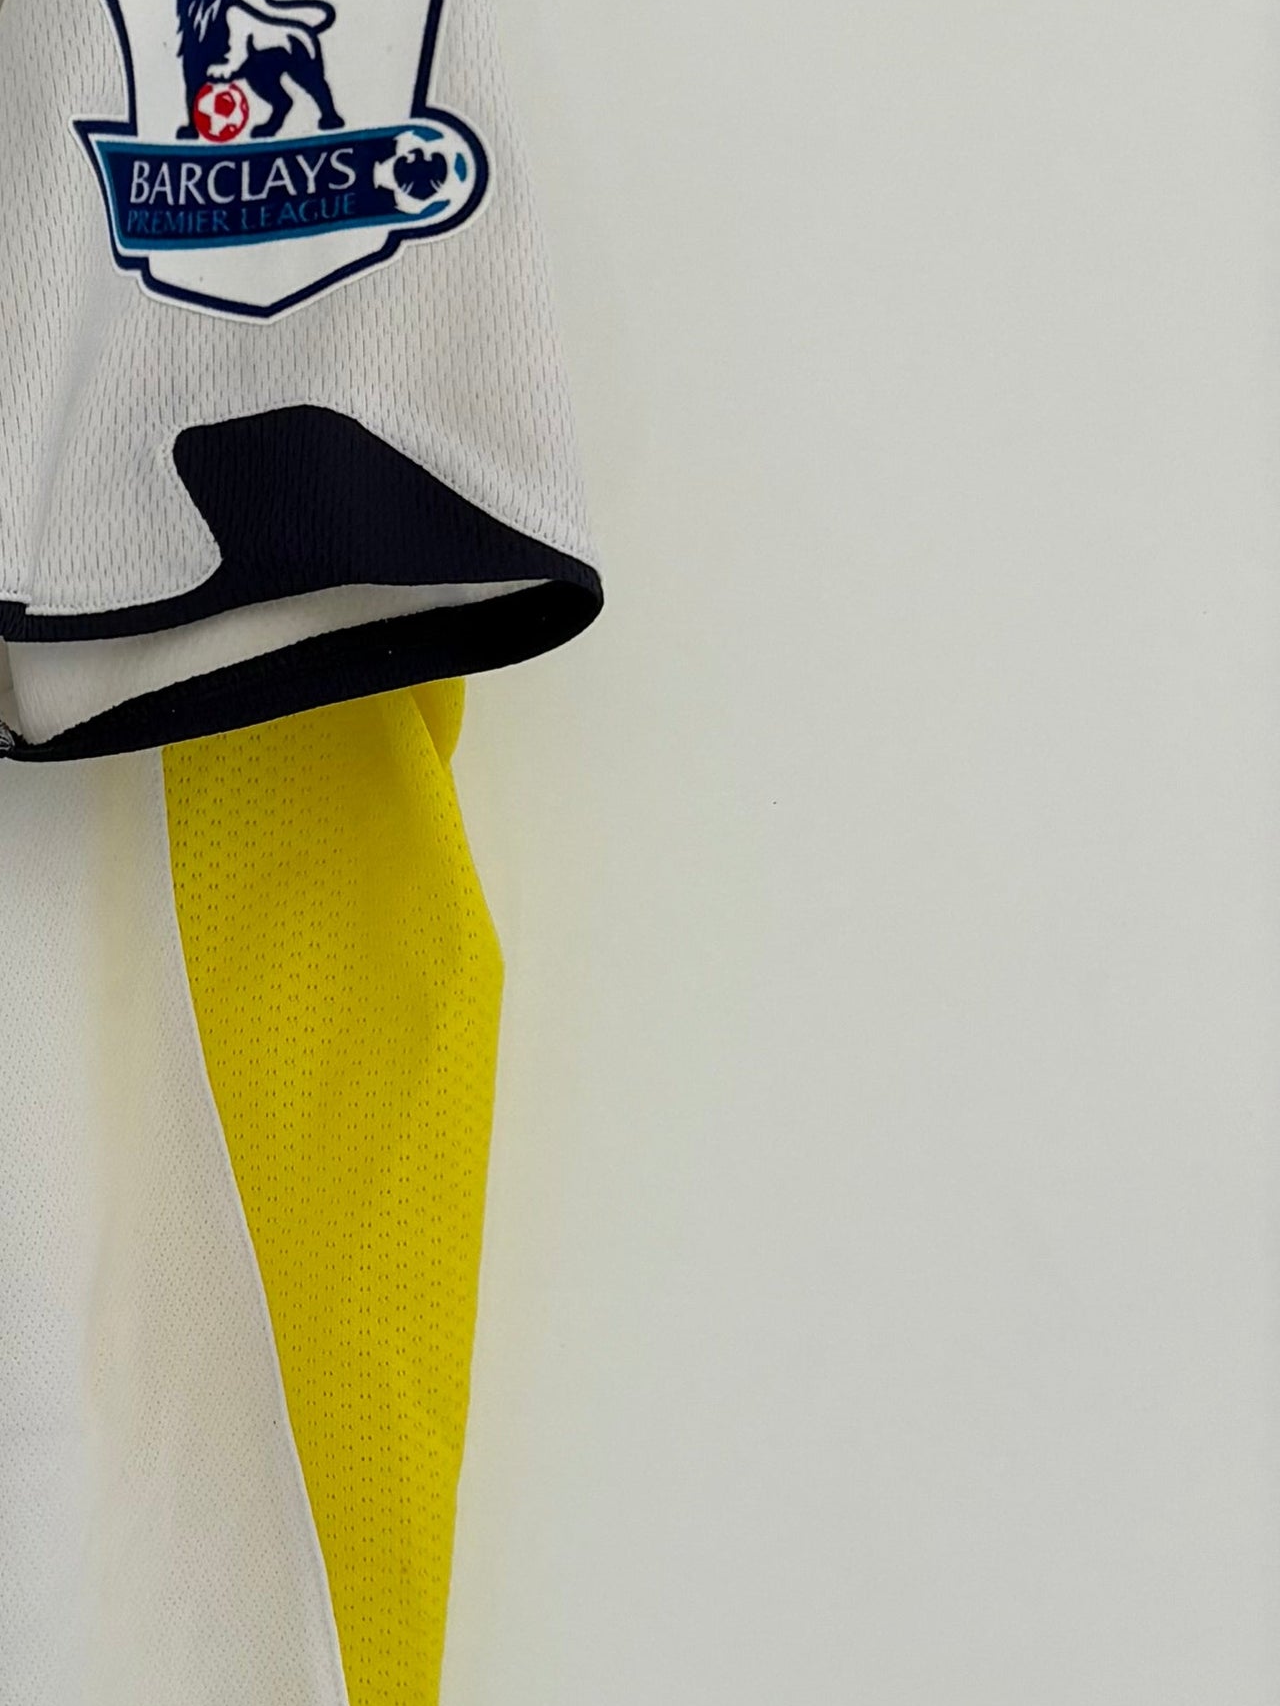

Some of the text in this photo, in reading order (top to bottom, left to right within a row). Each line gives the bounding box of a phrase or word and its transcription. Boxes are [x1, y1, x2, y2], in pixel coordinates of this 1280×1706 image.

[130, 148, 356, 205] BARCLAYS
[127, 194, 355, 234] PREMIER LEAGUE
